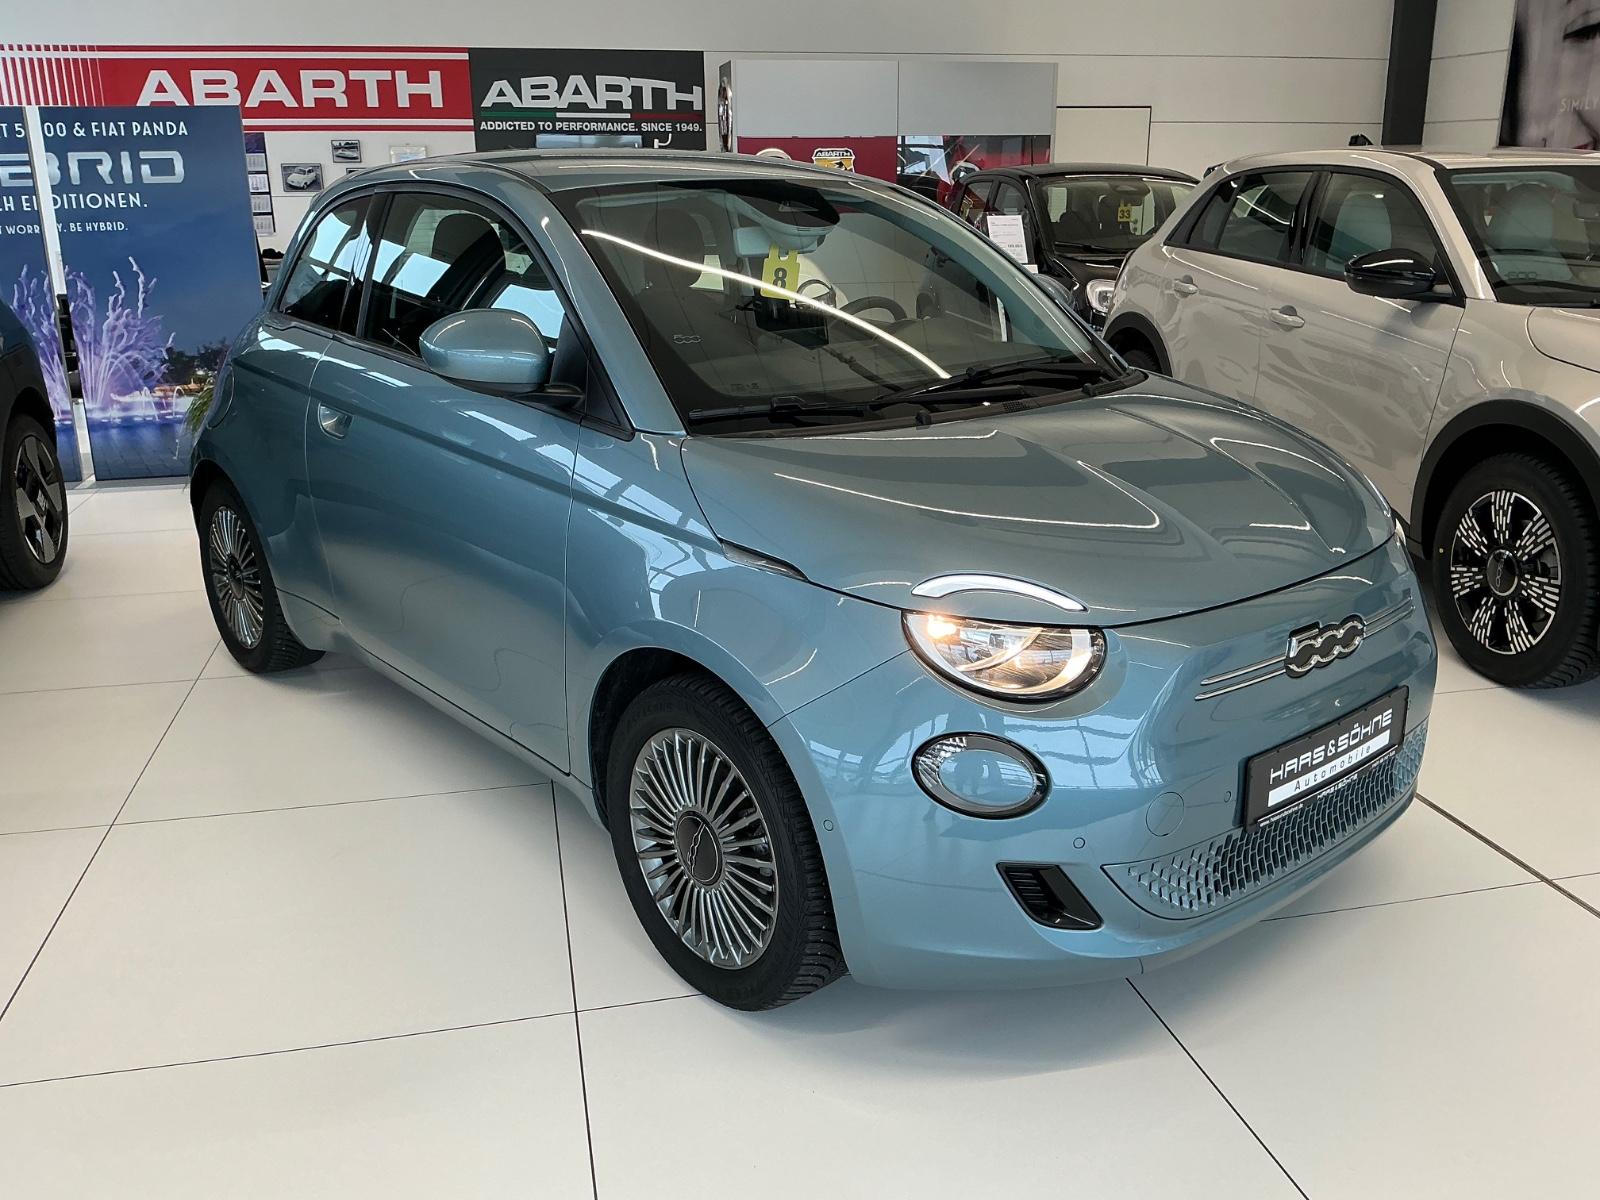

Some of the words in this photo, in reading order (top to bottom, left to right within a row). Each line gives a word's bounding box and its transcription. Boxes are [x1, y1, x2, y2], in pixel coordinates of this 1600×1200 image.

[136, 69, 444, 108] ABARTH
[480, 75, 703, 110] ABARTH
[73, 121, 86, 137] &
[91, 121, 126, 137] FIAT
[132, 121, 188, 136] PANDA
[480, 121, 535, 131] ADDICTED
[537, 121, 553, 131] TO
[555, 122, 638, 132] PERFORMANCE.
[641, 122, 672, 132] SINCE
[675, 123, 702, 132] 1949.
[1119, 209, 1131, 219] 33
[70, 222, 82, 232] BE
[86, 221, 128, 232] HYBRID.
[773, 267, 787, 290] 8
[1285, 614, 1366, 678] 500
[1293, 744, 1372, 793] Automobile
